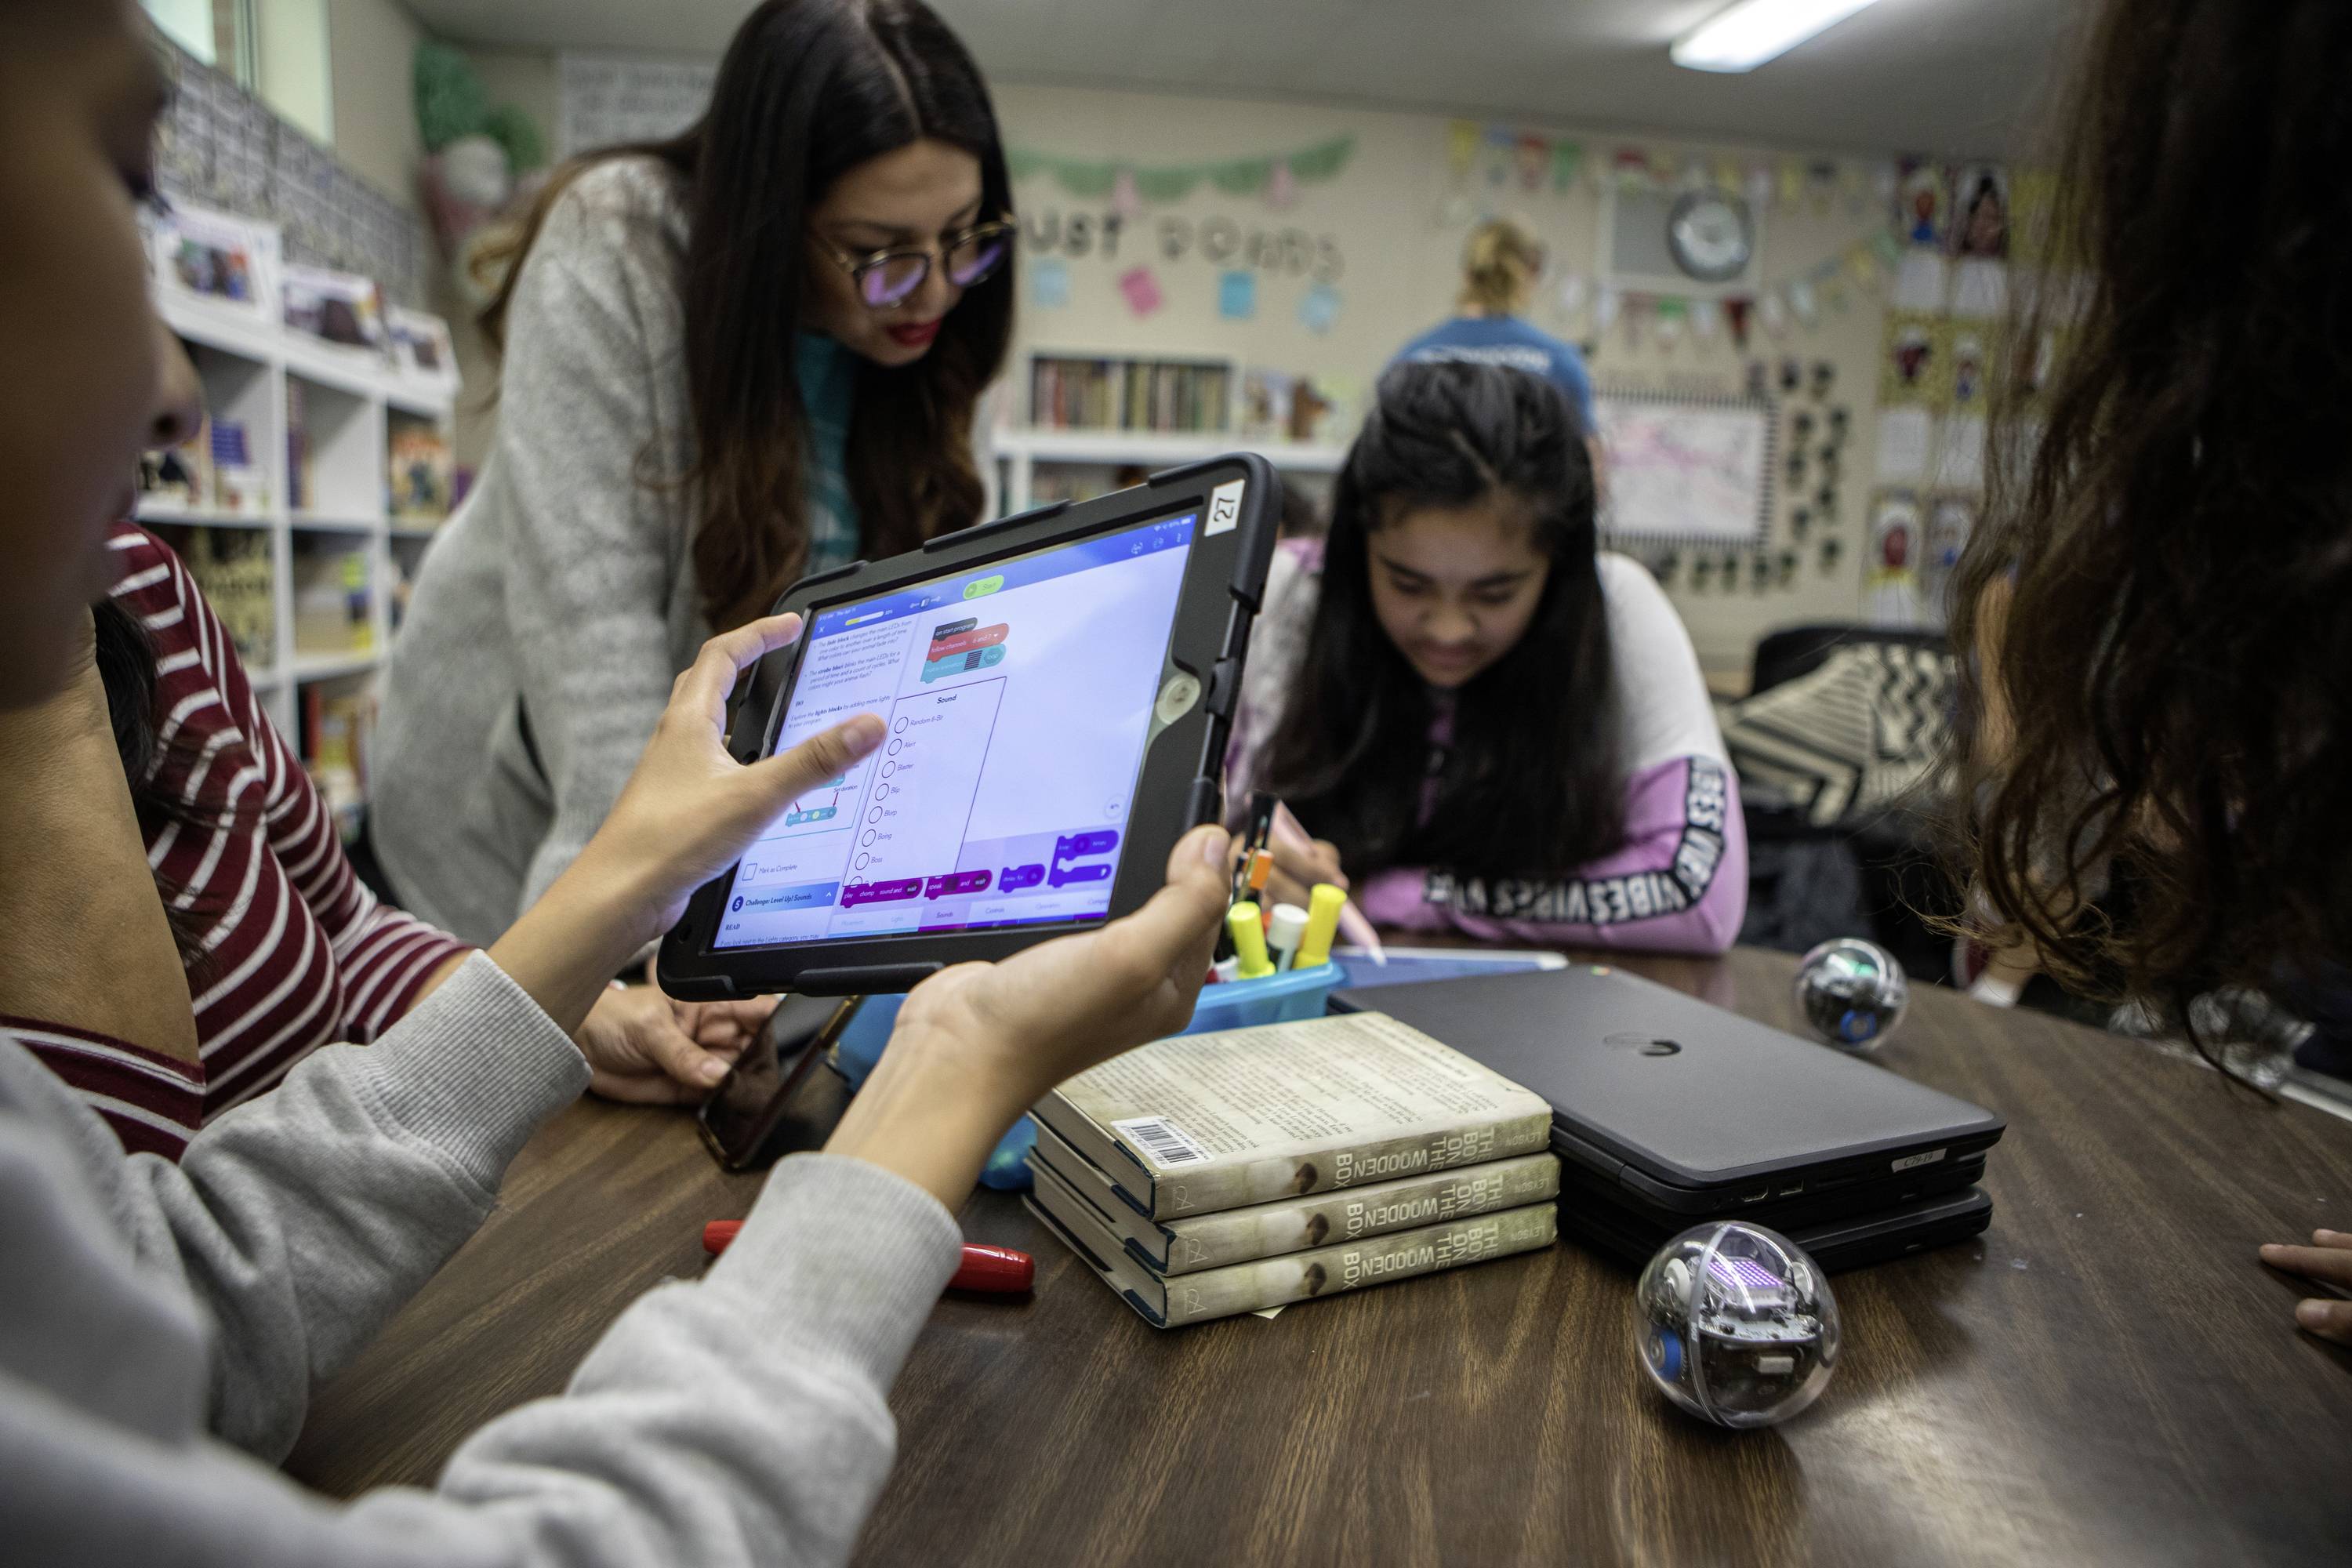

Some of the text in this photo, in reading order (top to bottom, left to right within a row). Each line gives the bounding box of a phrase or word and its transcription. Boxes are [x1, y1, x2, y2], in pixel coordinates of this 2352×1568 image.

[1214, 497, 1235, 522] 27
[953, 622, 975, 633] program
[837, 634, 849, 643] block
[930, 643, 946, 653] follow
[936, 694, 957, 704] Sound
[909, 717, 931, 726] Random
[897, 762, 914, 771] Blaster
[883, 808, 898, 818] Blurp
[877, 832, 892, 841] Boing
[775, 863, 798, 873] Complete
[927, 881, 942, 891] speak
[858, 889, 875, 898] chomp
[1587, 871, 1686, 924] VIBES
[744, 897, 771, 907] Challenge:
[783, 895, 793, 903] Up!
[793, 892, 813, 901] Sounds
[1504, 1131, 1541, 1147] LEYSON
[1334, 1127, 1494, 1189] THE BOY ON THE WOODEN BOX
[1513, 1178, 1550, 1194] LEYSON
[1345, 1174, 1504, 1240] THE BOY ON THE WOODEN BOX
[1511, 1225, 1545, 1242] LEYSON
[1342, 1222, 1499, 1290] THE BOY ON THE WOODEN BOX
